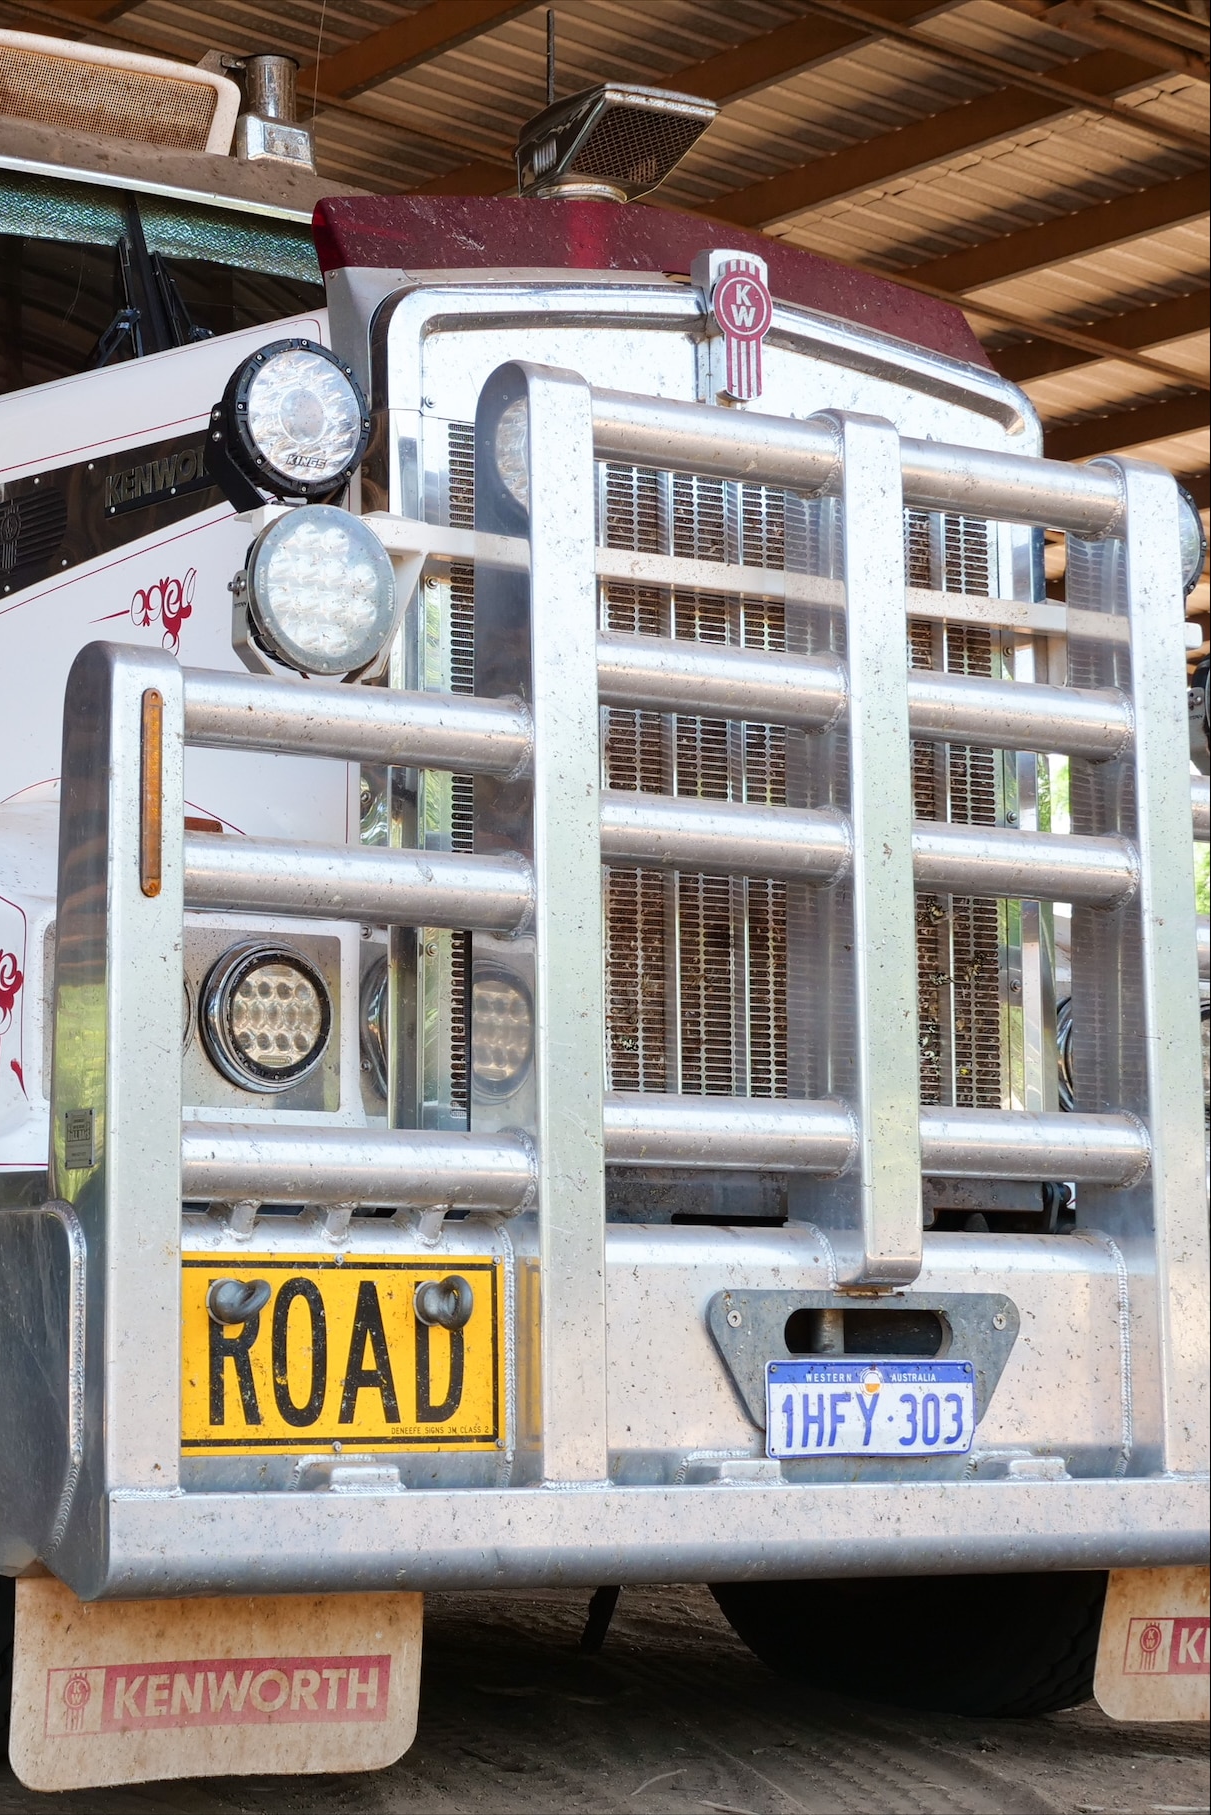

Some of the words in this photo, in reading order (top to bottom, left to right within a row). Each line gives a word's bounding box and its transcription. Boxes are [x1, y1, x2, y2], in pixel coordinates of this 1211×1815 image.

[286, 454, 327, 469] KINGS
[208, 1277, 464, 1427] ROAD
[806, 1373, 852, 1382] WESTERN
[891, 1373, 936, 1382] AUSTRALIA
[391, 1427, 421, 1435] DENEEFE
[424, 1426, 444, 1434] SIGNS
[460, 1425, 481, 1434] CLASS
[484, 1425, 490, 1433] 2
[113, 1667, 379, 1720] KENWORTH
